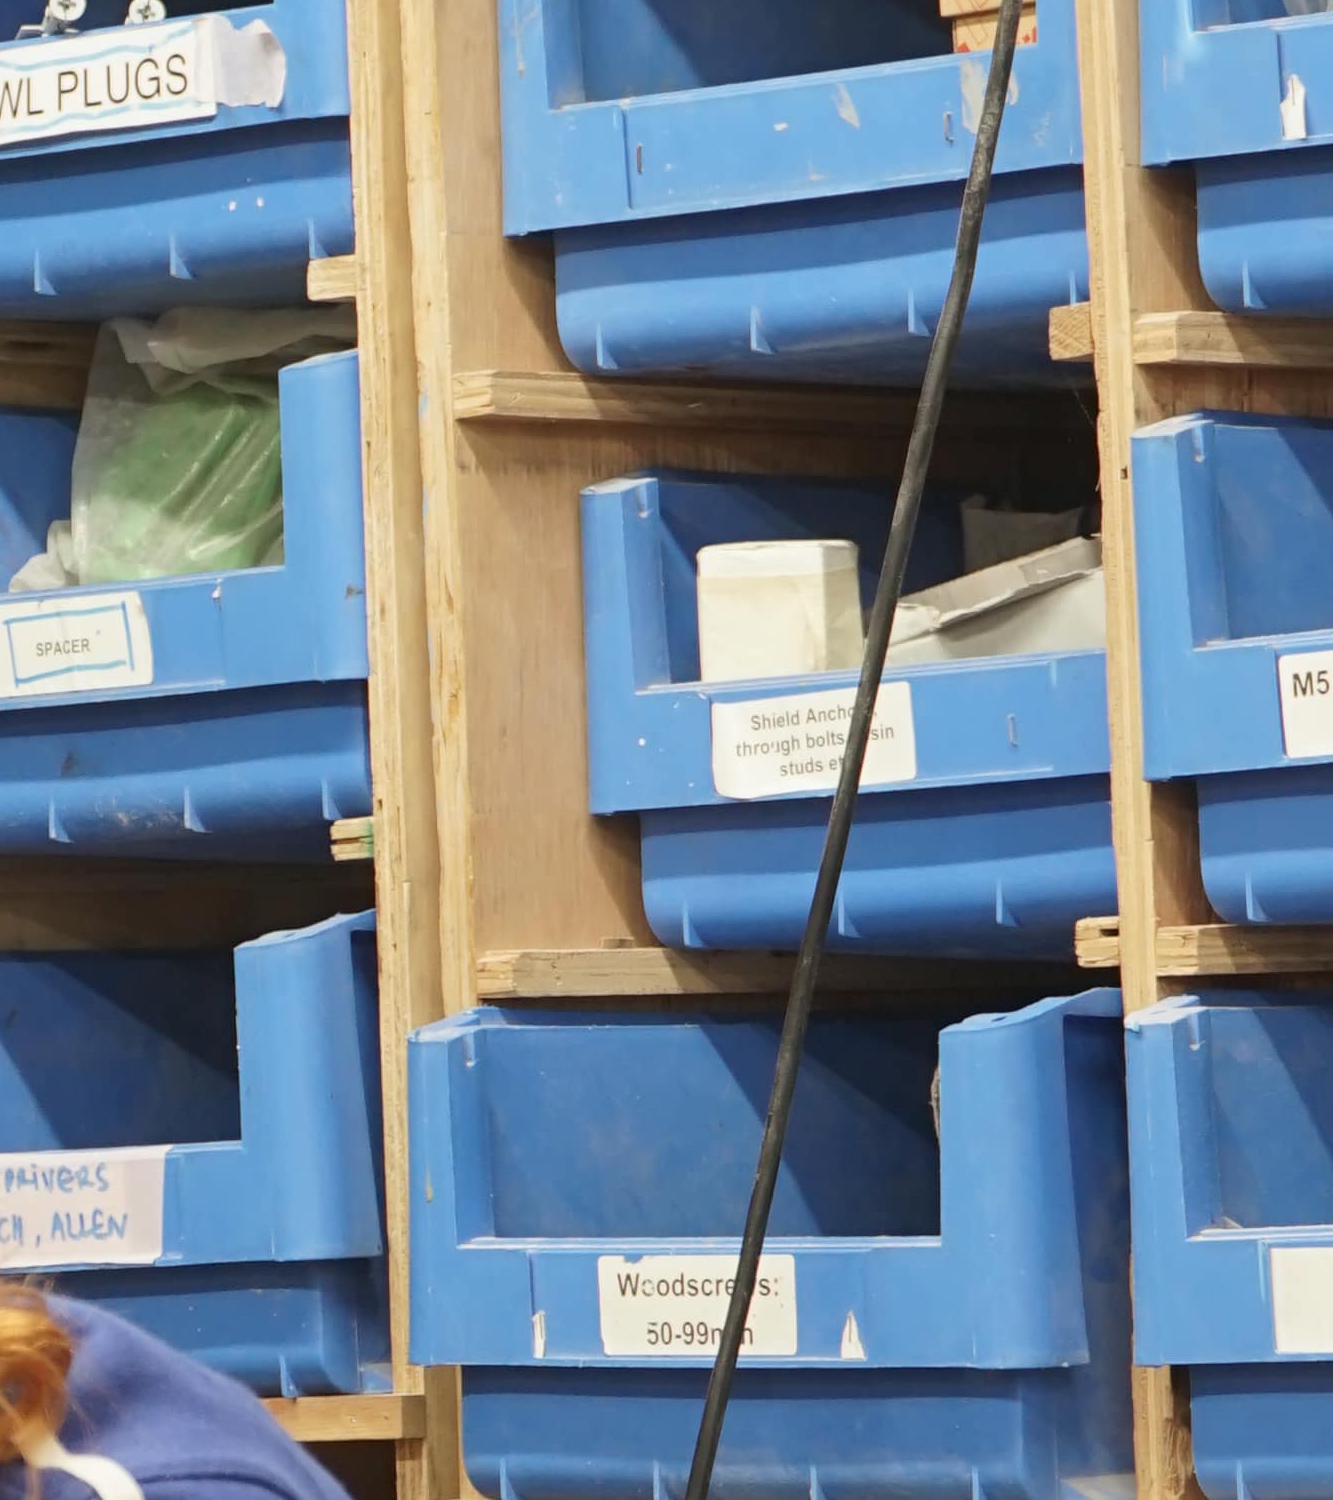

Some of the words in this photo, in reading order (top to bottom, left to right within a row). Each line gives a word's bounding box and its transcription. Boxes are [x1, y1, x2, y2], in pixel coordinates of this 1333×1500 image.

[57, 53, 188, 112] PLUGS
[36, 637, 91, 658] SPACER
[1292, 669, 1331, 698] M5
[750, 709, 800, 732] Shield
[736, 733, 800, 757] through
[780, 756, 824, 777] studs
[50, 1207, 128, 1242] ALLEN
[617, 1272, 780, 1297] Woodscres:
